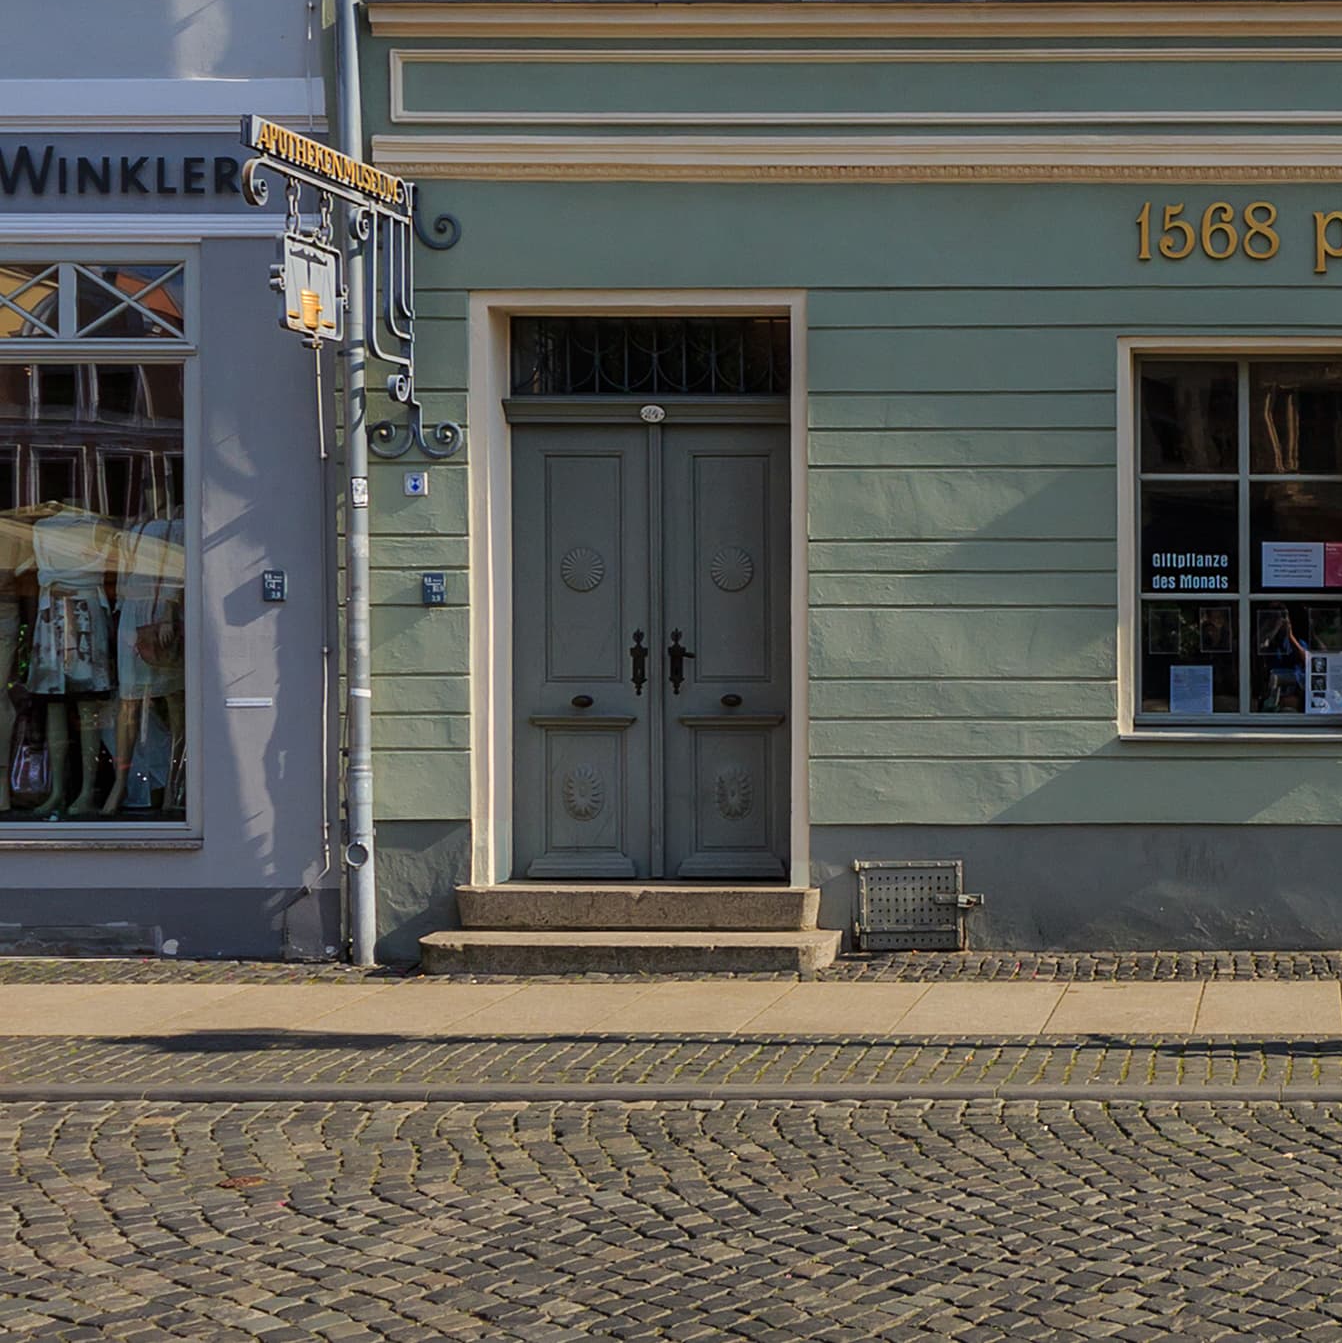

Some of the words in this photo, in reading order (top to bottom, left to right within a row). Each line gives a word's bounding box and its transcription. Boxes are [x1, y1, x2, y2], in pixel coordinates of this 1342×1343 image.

[257, 121, 400, 204] APOTHEKENMUSEUM
[1137, 201, 1280, 260] 1568
[1152, 552, 1229, 569] Giftpflanze
[1152, 574, 1176, 590] des
[1179, 574, 1229, 590] Monats
